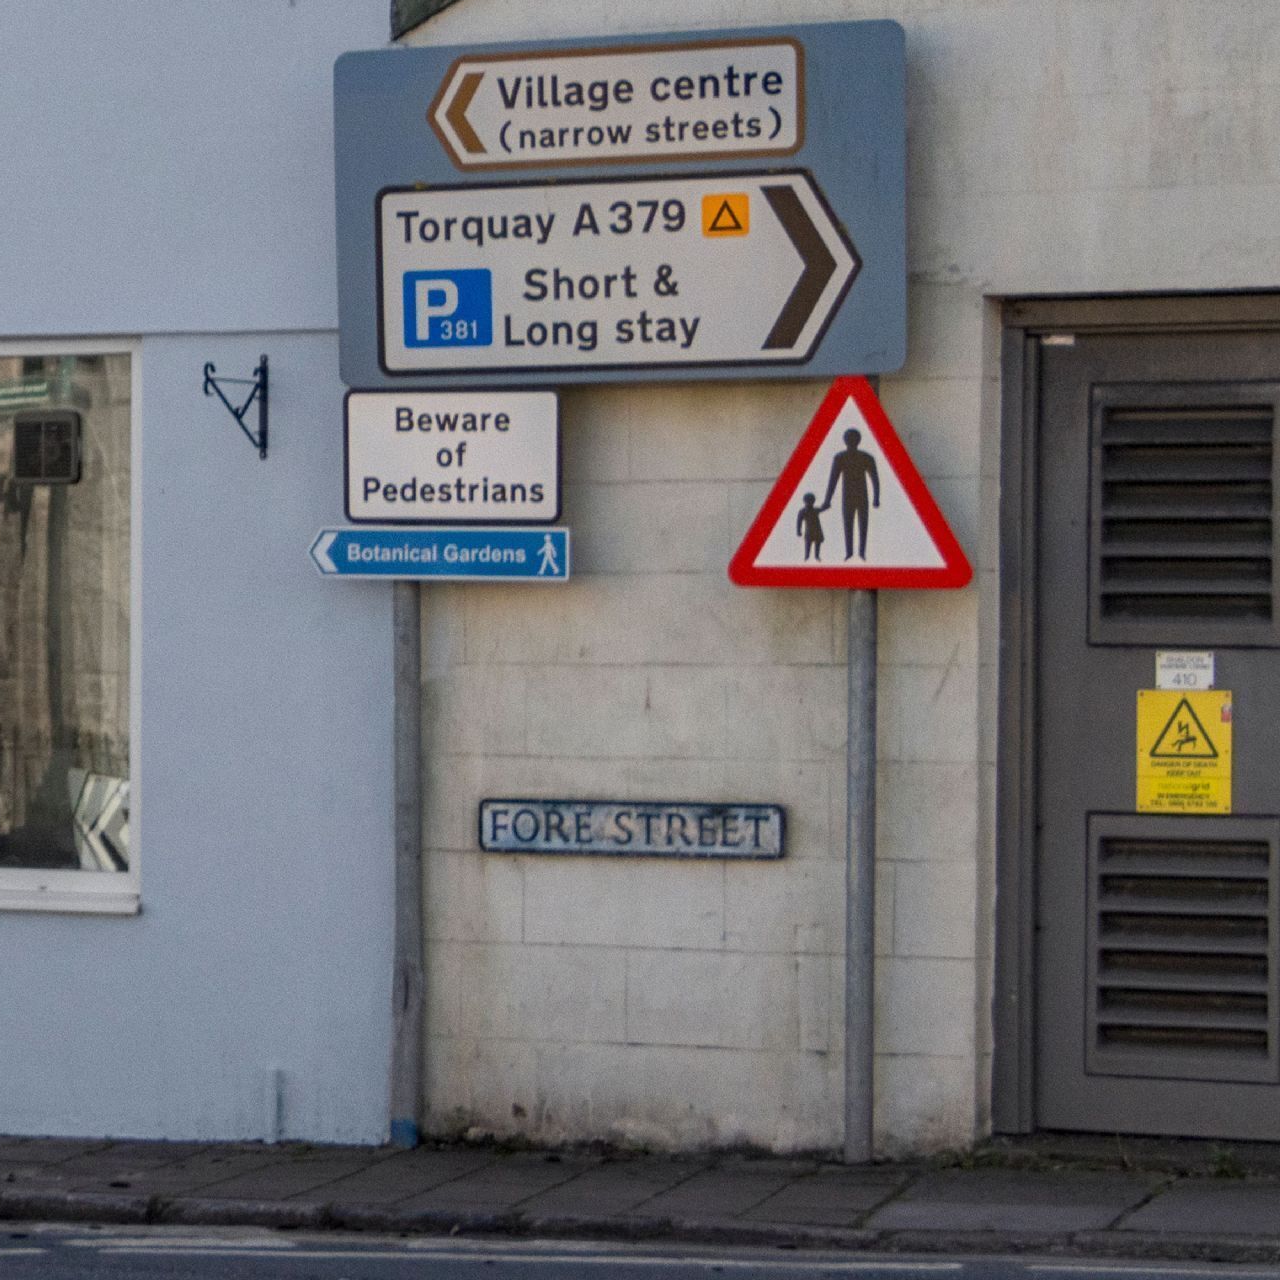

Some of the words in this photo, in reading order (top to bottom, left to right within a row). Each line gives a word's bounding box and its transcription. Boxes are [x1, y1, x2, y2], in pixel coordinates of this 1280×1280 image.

[497, 72, 634, 111] Village
[650, 65, 784, 102] centre
[498, 120, 632, 154] (narrow
[645, 107, 783, 143] streets)
[397, 208, 556, 247] Torquay
[523, 266, 638, 302] Short
[652, 265, 680, 298] &
[415, 278, 459, 341] P
[440, 319, 479, 340] 381
[503, 314, 598, 351] Long
[615, 312, 701, 349] stay
[395, 407, 511, 433] Beware
[435, 441, 467, 468] of
[363, 477, 545, 504] Pedestrians
[347, 542, 437, 563] Botanical
[443, 543, 526, 564] Gardens
[490, 809, 594, 843] FORE
[612, 811, 771, 849] STREET
